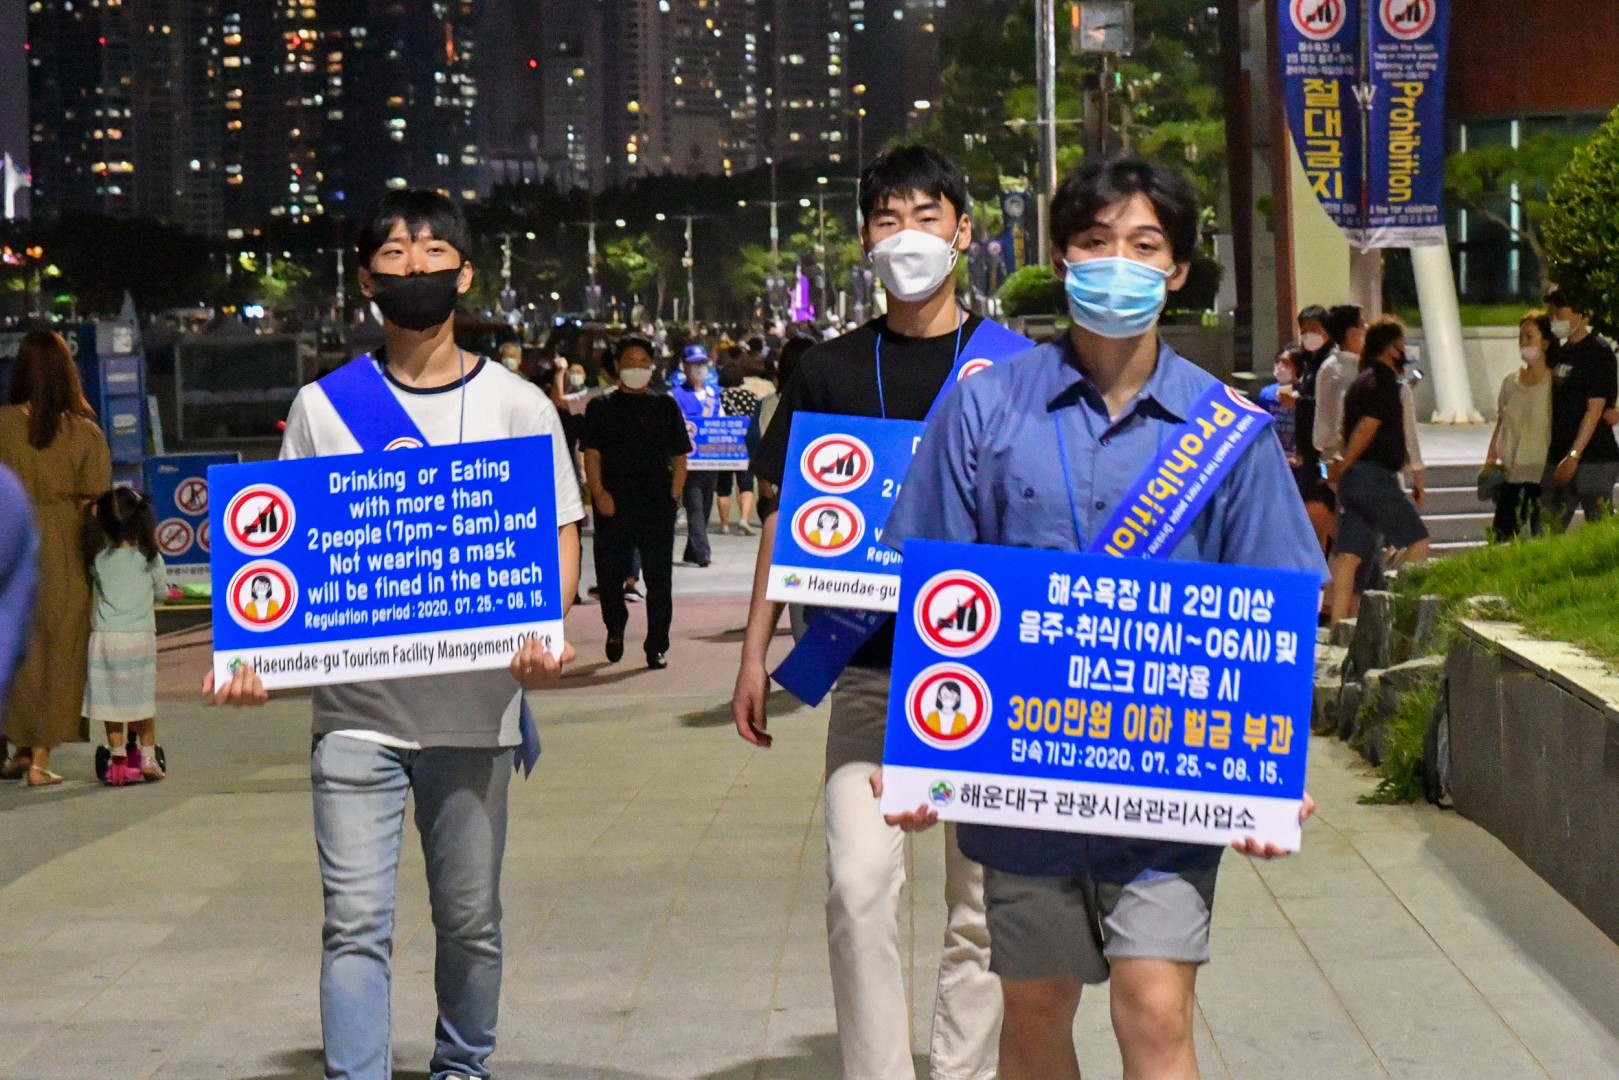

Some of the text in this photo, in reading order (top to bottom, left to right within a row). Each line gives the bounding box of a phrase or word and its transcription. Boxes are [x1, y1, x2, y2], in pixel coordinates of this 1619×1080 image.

[1303, 78, 1343, 199] 절대금지
[1388, 81, 1424, 202] Prohibition
[329, 458, 510, 494] Drinking or Eating
[349, 487, 493, 519] with more than
[504, 507, 537, 532] and
[330, 541, 516, 576] Not wearing a mask
[308, 562, 543, 605] will be fined in the beach
[807, 575, 897, 600] Haeundae-gu
[1048, 571, 1275, 623] 해수욕장 내 2인 이상
[304, 604, 368, 631] Regulation
[253, 652, 340, 675] Haeundae-gu
[343, 645, 390, 668] Tourism
[392, 642, 434, 665] Facility
[437, 635, 514, 660] Management
[1275, 630, 1298, 665] 및
[1068, 655, 1241, 702] 마스크 미착용 시
[1007, 695, 1294, 755] 300만원 이하 벌금 부과
[960, 782, 1256, 830] 해운대구 관광시설관리사업소
